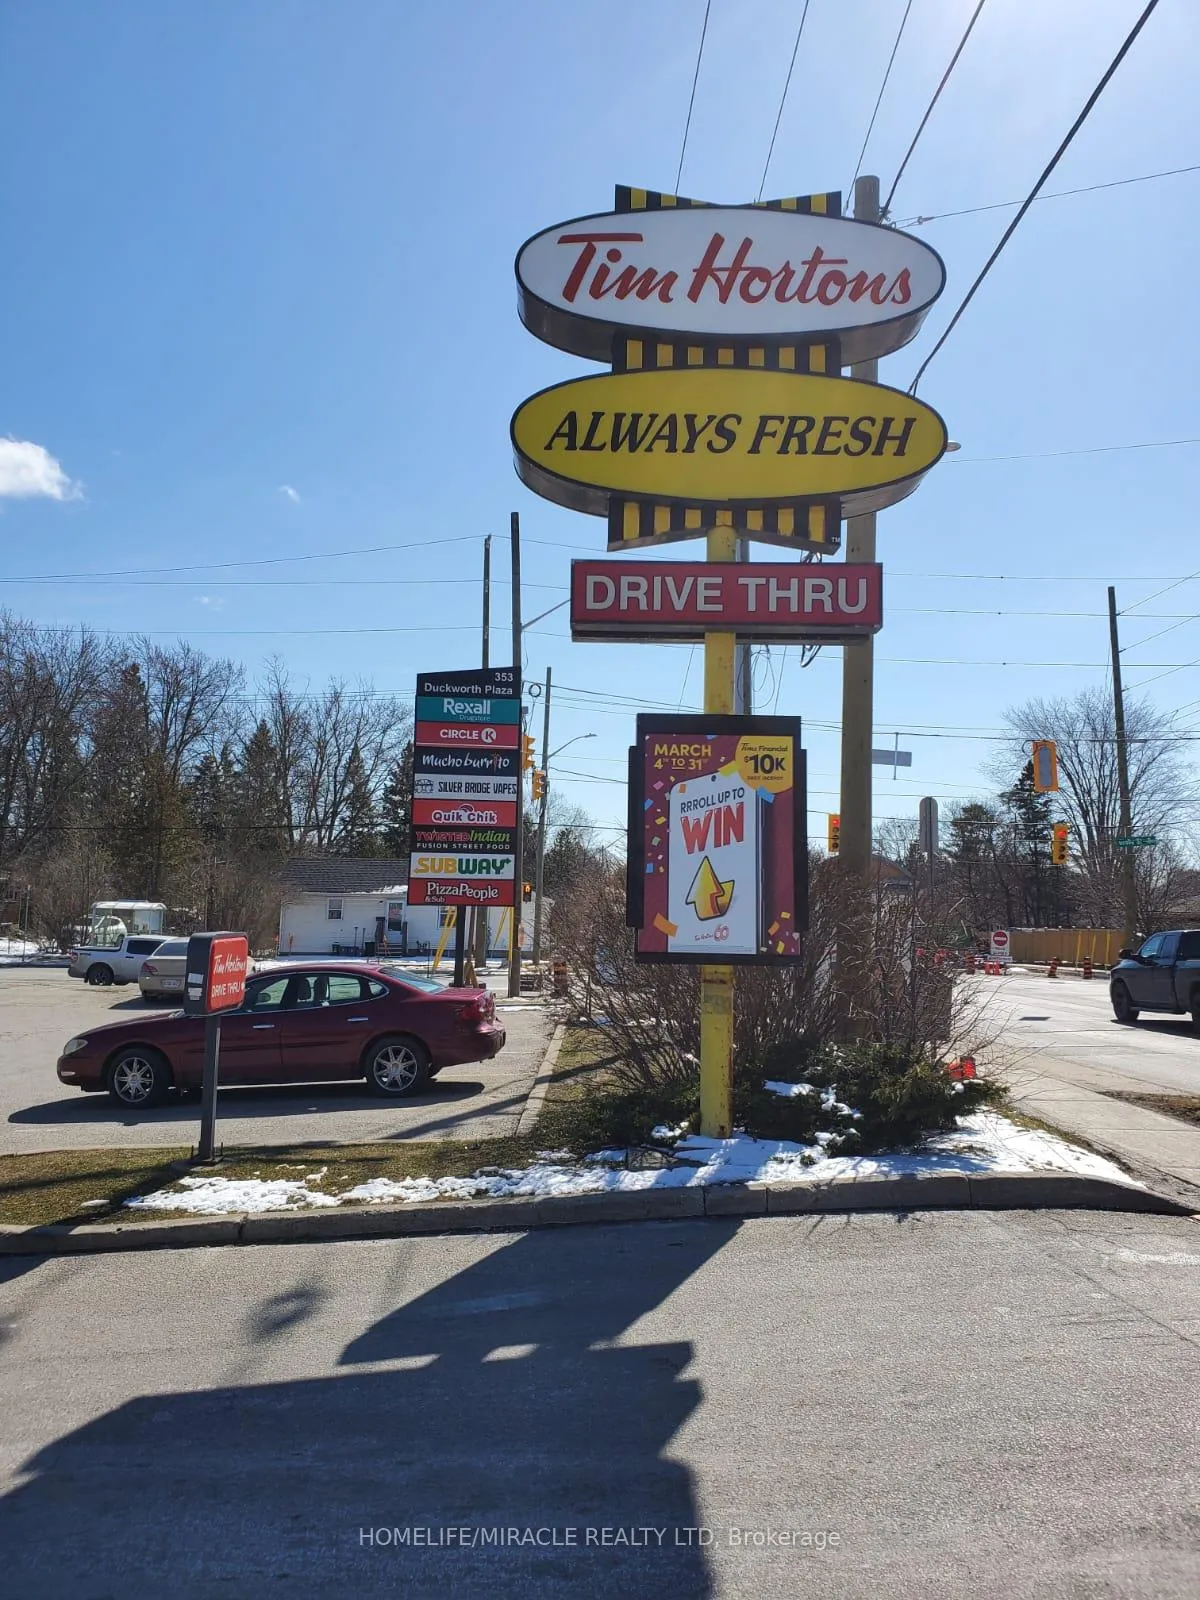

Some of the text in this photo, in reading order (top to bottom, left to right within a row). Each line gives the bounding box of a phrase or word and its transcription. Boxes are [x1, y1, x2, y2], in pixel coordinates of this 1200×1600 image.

[557, 232, 912, 305] Tim Hortons
[544, 411, 917, 456] ALWAYS FRESH
[584, 575, 869, 615] DRIVE THRU
[494, 672, 514, 682] 353
[424, 682, 513, 695] Duckworth Plaza
[443, 697, 491, 715] Rexall
[439, 729, 479, 740] CIRCLE
[654, 743, 712, 757] MARCH
[671, 758, 686, 767] TO
[744, 753, 786, 775] $10K
[438, 781, 517, 795] SILVER BRIDGE VAPES
[680, 787, 745, 814] RRROLL UP TO
[469, 829, 511, 842] Indian
[680, 801, 745, 855] WIN
[414, 857, 512, 875] SUBWAY
[211, 981, 241, 998] DRIVE THRU
